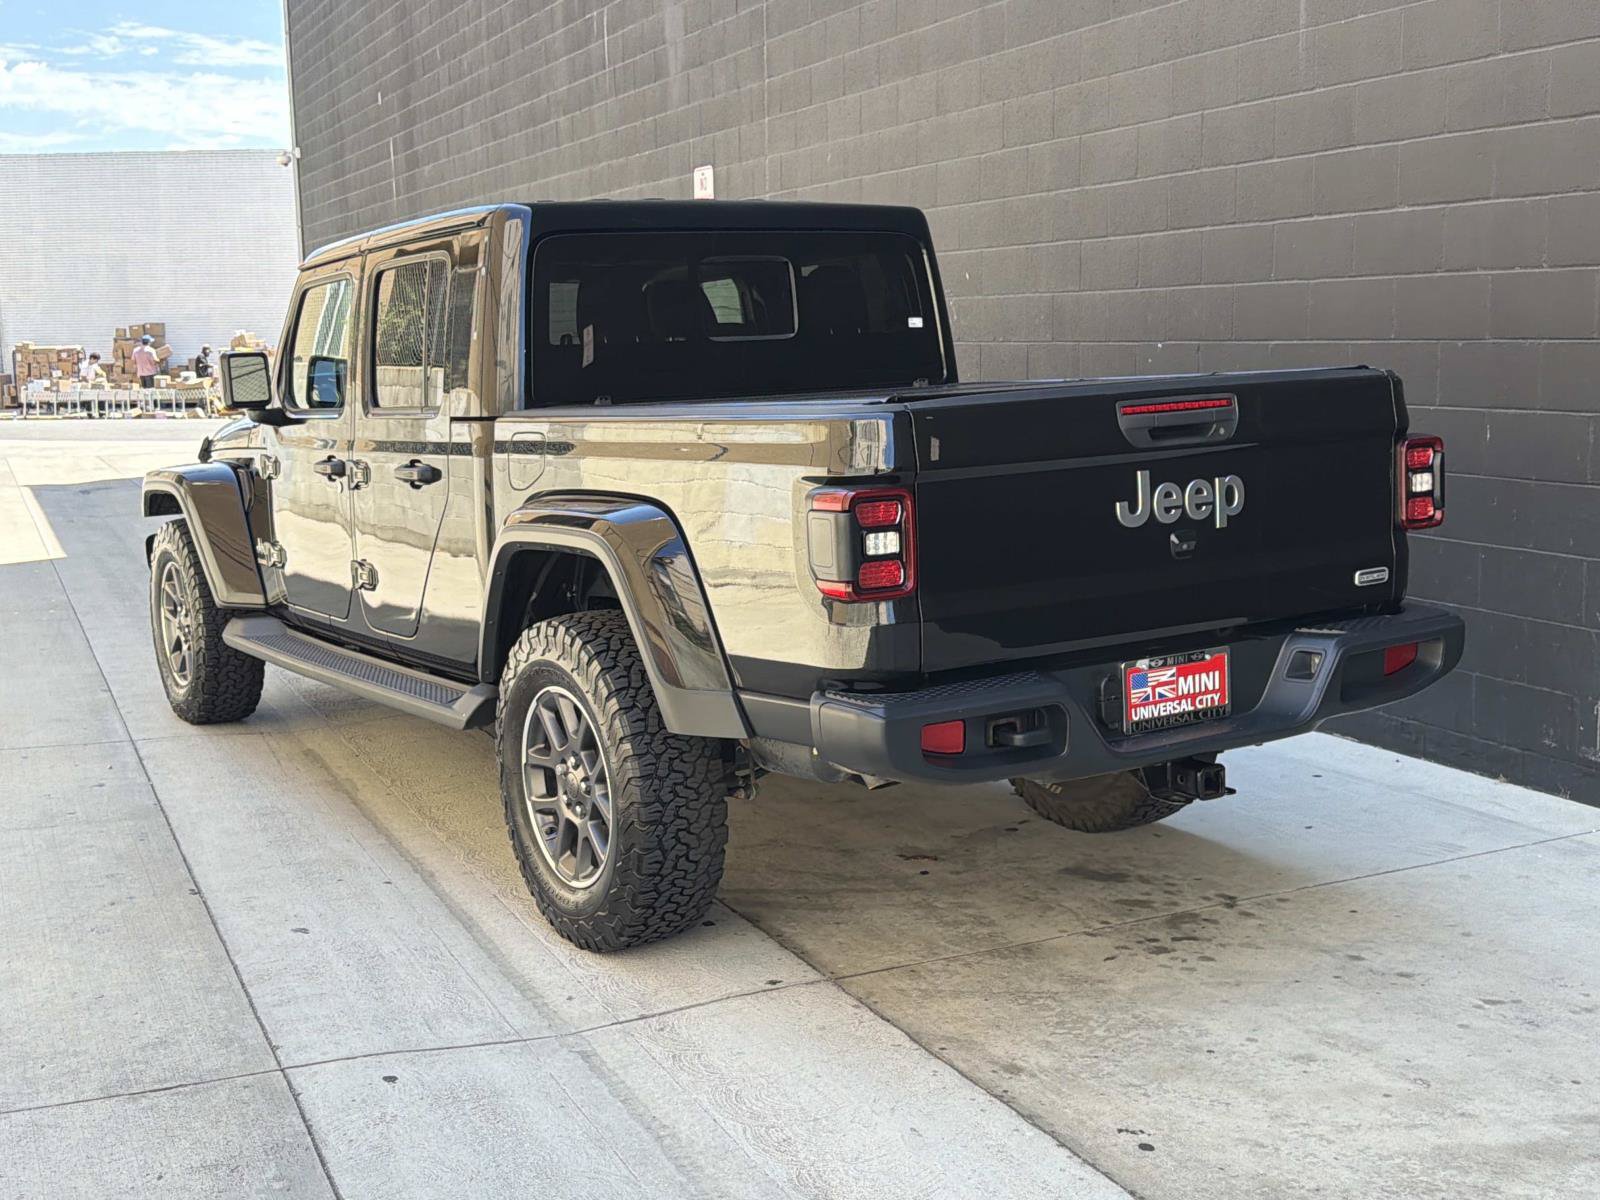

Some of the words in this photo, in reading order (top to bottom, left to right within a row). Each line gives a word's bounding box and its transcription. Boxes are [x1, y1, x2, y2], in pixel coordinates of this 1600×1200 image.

[1115, 470, 1245, 528] Jeep
[1167, 655, 1188, 665] MINI
[1178, 671, 1220, 696] MINI
[1132, 698, 1194, 720] UNIVERSAL
[1196, 693, 1220, 709] CITY
[1133, 713, 1195, 731] UNIVERSAL
[1199, 706, 1225, 719] CITY
